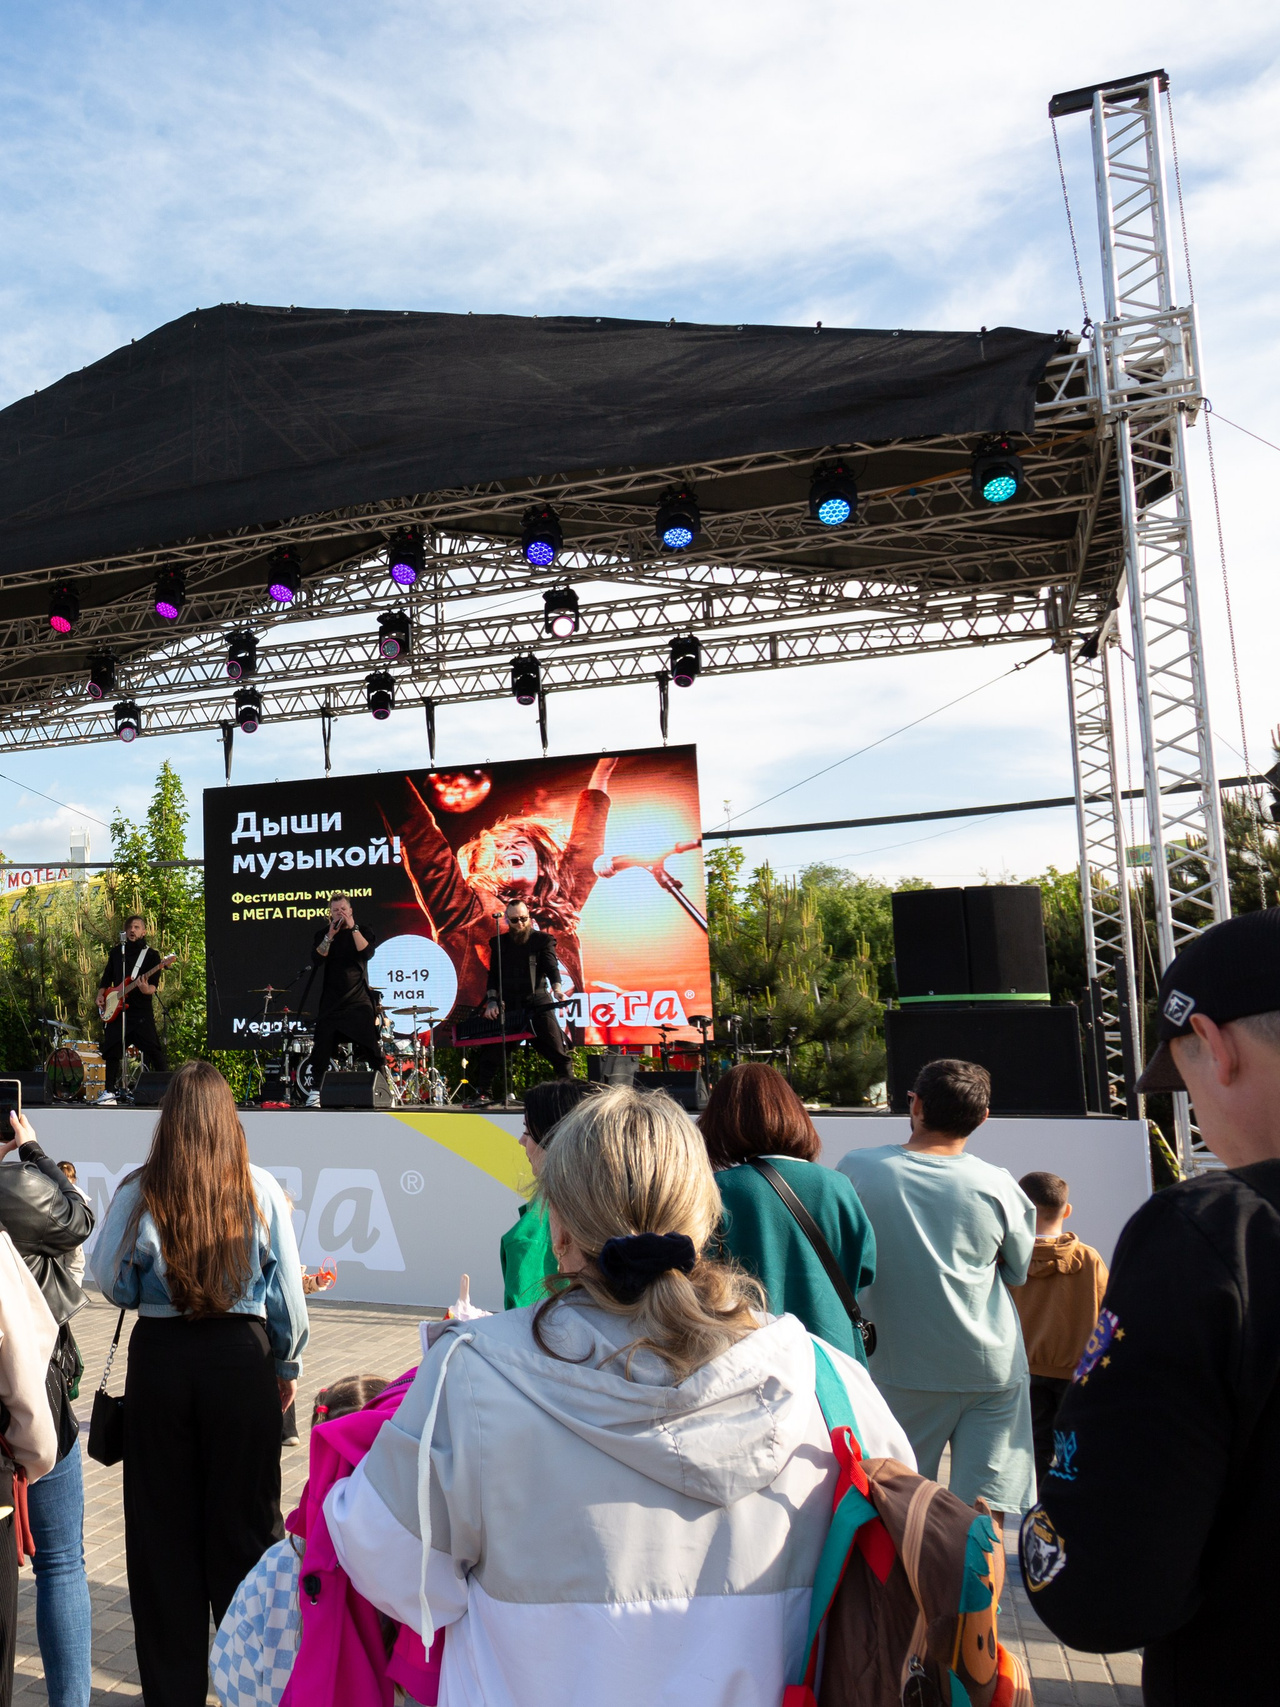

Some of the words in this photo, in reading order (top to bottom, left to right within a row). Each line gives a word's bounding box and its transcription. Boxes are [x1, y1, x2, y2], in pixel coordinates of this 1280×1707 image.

[231, 811, 342, 845] Дыши
[232, 836, 402, 880] музыкой!
[231, 889, 312, 904] Фестиваль
[232, 912, 240, 921] в
[243, 907, 284, 920] МЕГА
[387, 969, 430, 983] 18-19
[393, 989, 424, 1000] мая
